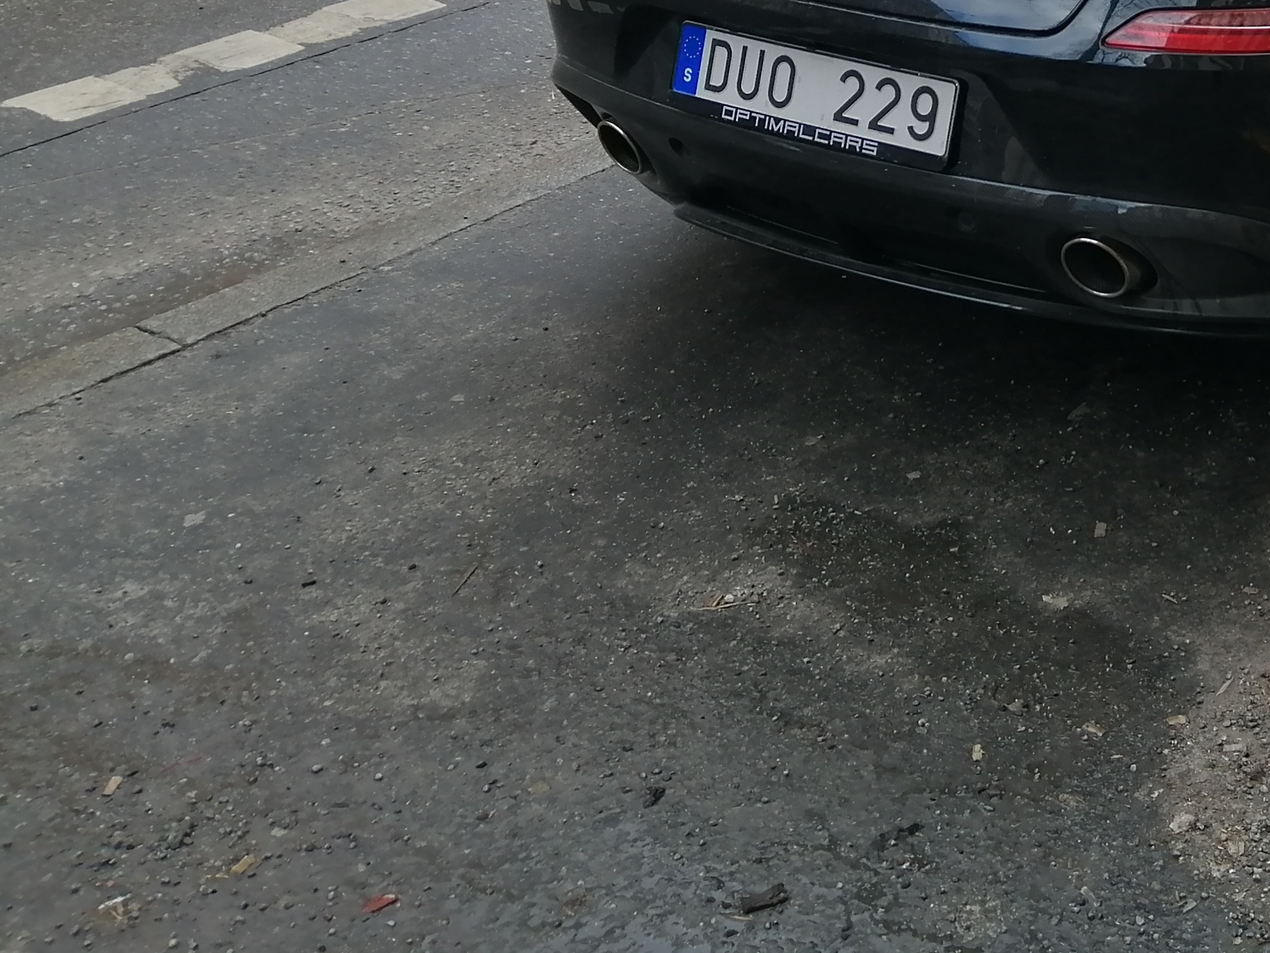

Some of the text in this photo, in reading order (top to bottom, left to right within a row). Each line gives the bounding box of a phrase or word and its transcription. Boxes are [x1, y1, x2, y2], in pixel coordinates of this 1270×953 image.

[683, 38, 939, 141] S DUO 229
[721, 105, 879, 156] OPTIMALCARS
